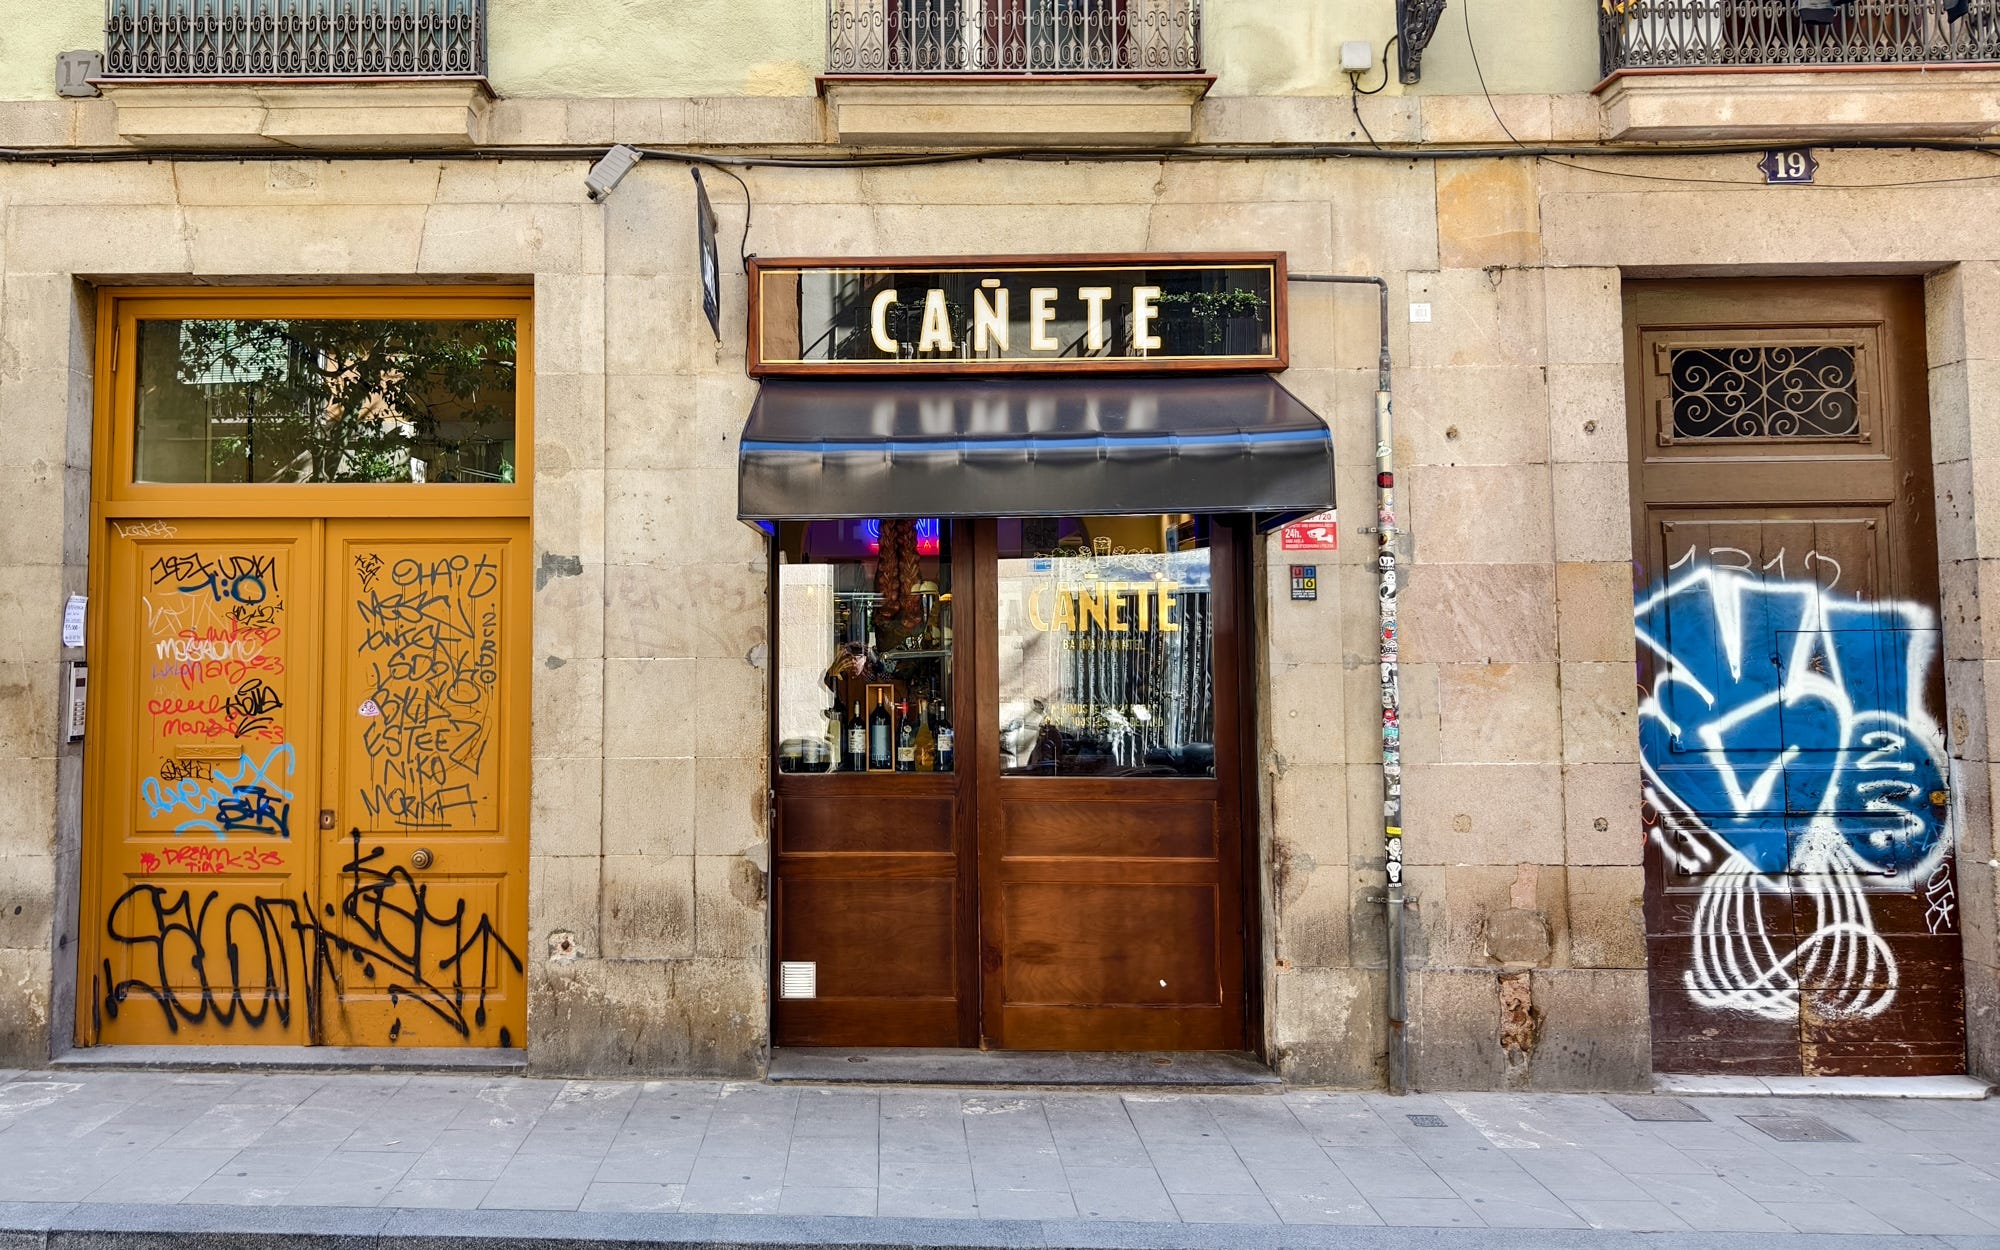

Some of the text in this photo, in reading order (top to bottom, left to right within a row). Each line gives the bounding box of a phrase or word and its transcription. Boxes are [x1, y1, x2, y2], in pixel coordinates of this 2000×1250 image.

[63, 60, 91, 87] 17
[1775, 152, 1806, 178] 19
[870, 278, 1162, 352] CAÑETE
[1028, 573, 1180, 632] CAÑETE
